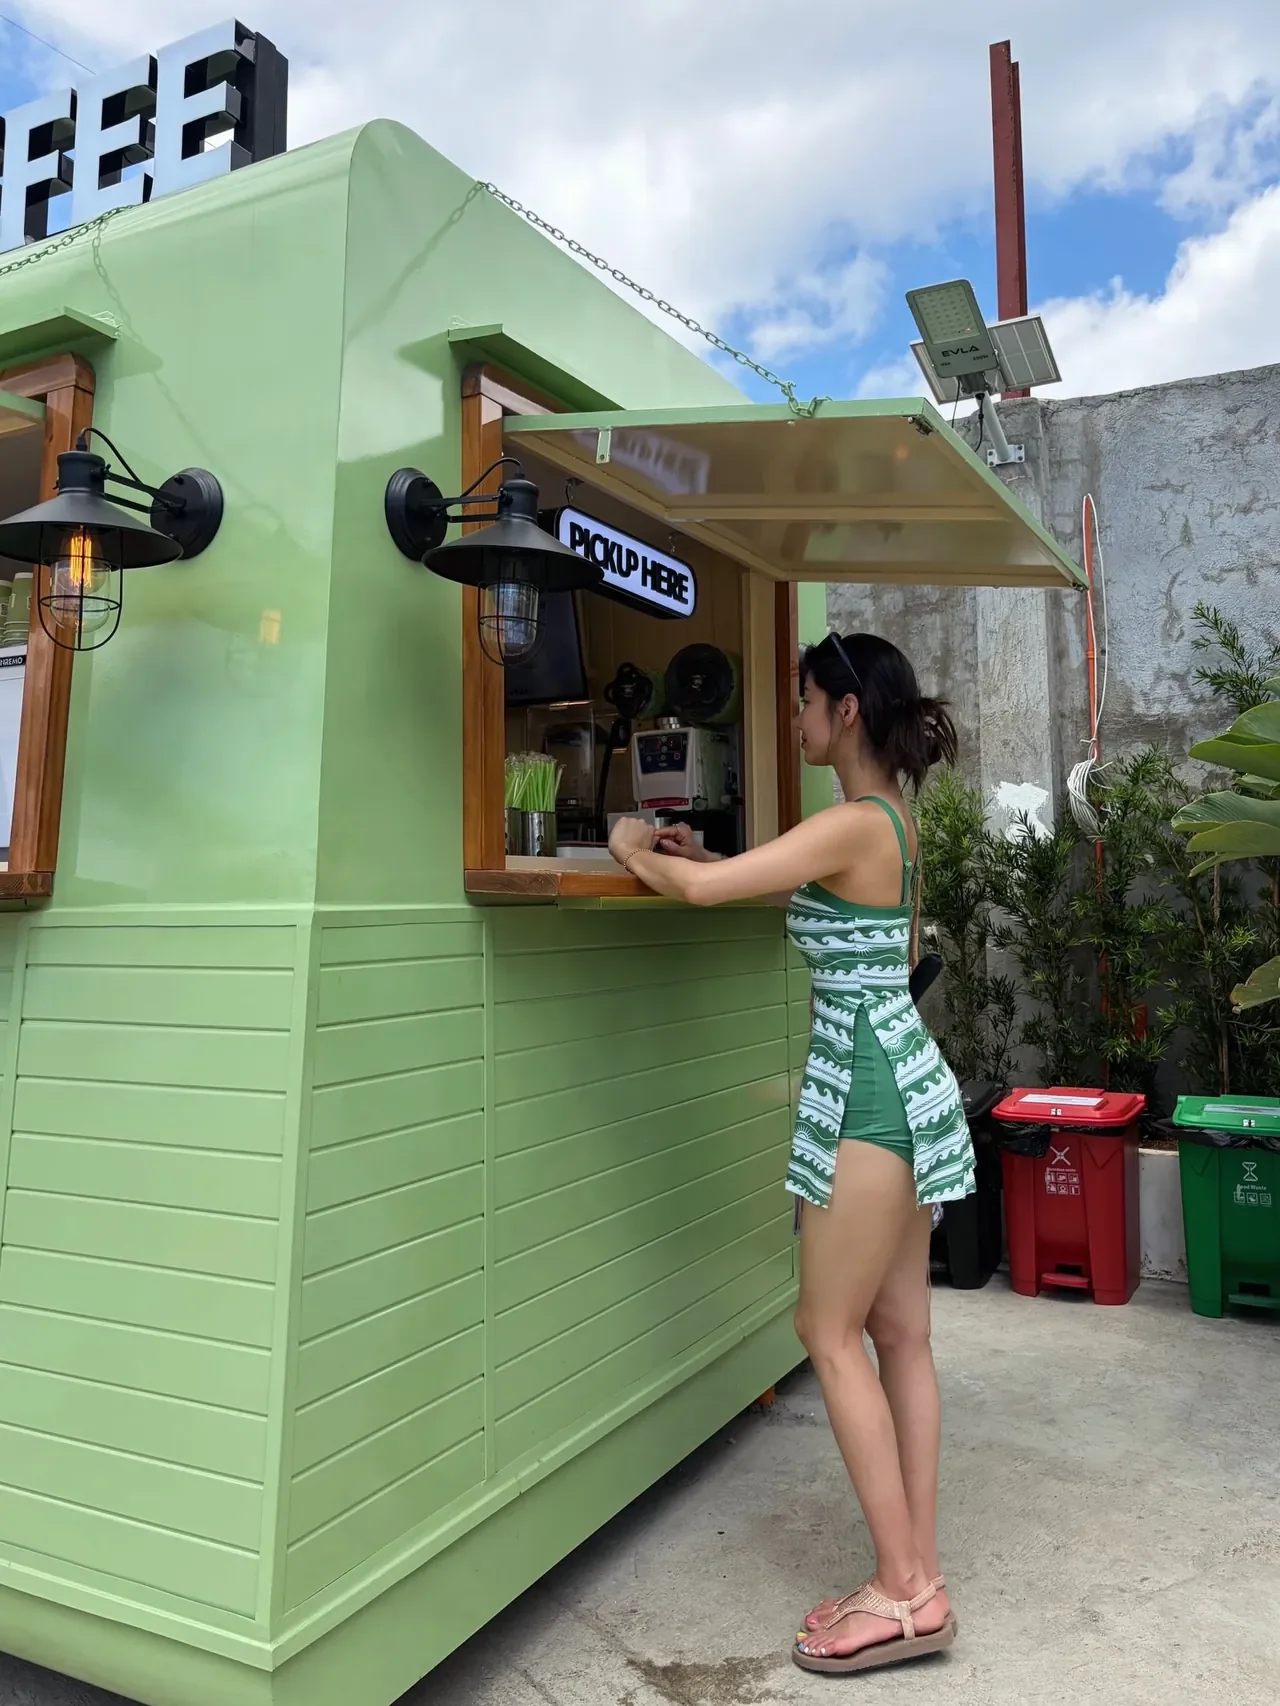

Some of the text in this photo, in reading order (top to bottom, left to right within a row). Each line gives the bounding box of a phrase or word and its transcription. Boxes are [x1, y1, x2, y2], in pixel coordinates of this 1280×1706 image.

[0, 18, 254, 255] FEE
[941, 345, 980, 357] EVLA
[569, 522, 688, 605] PICKUP HERE
[0, 656, 23, 666] NREMO
